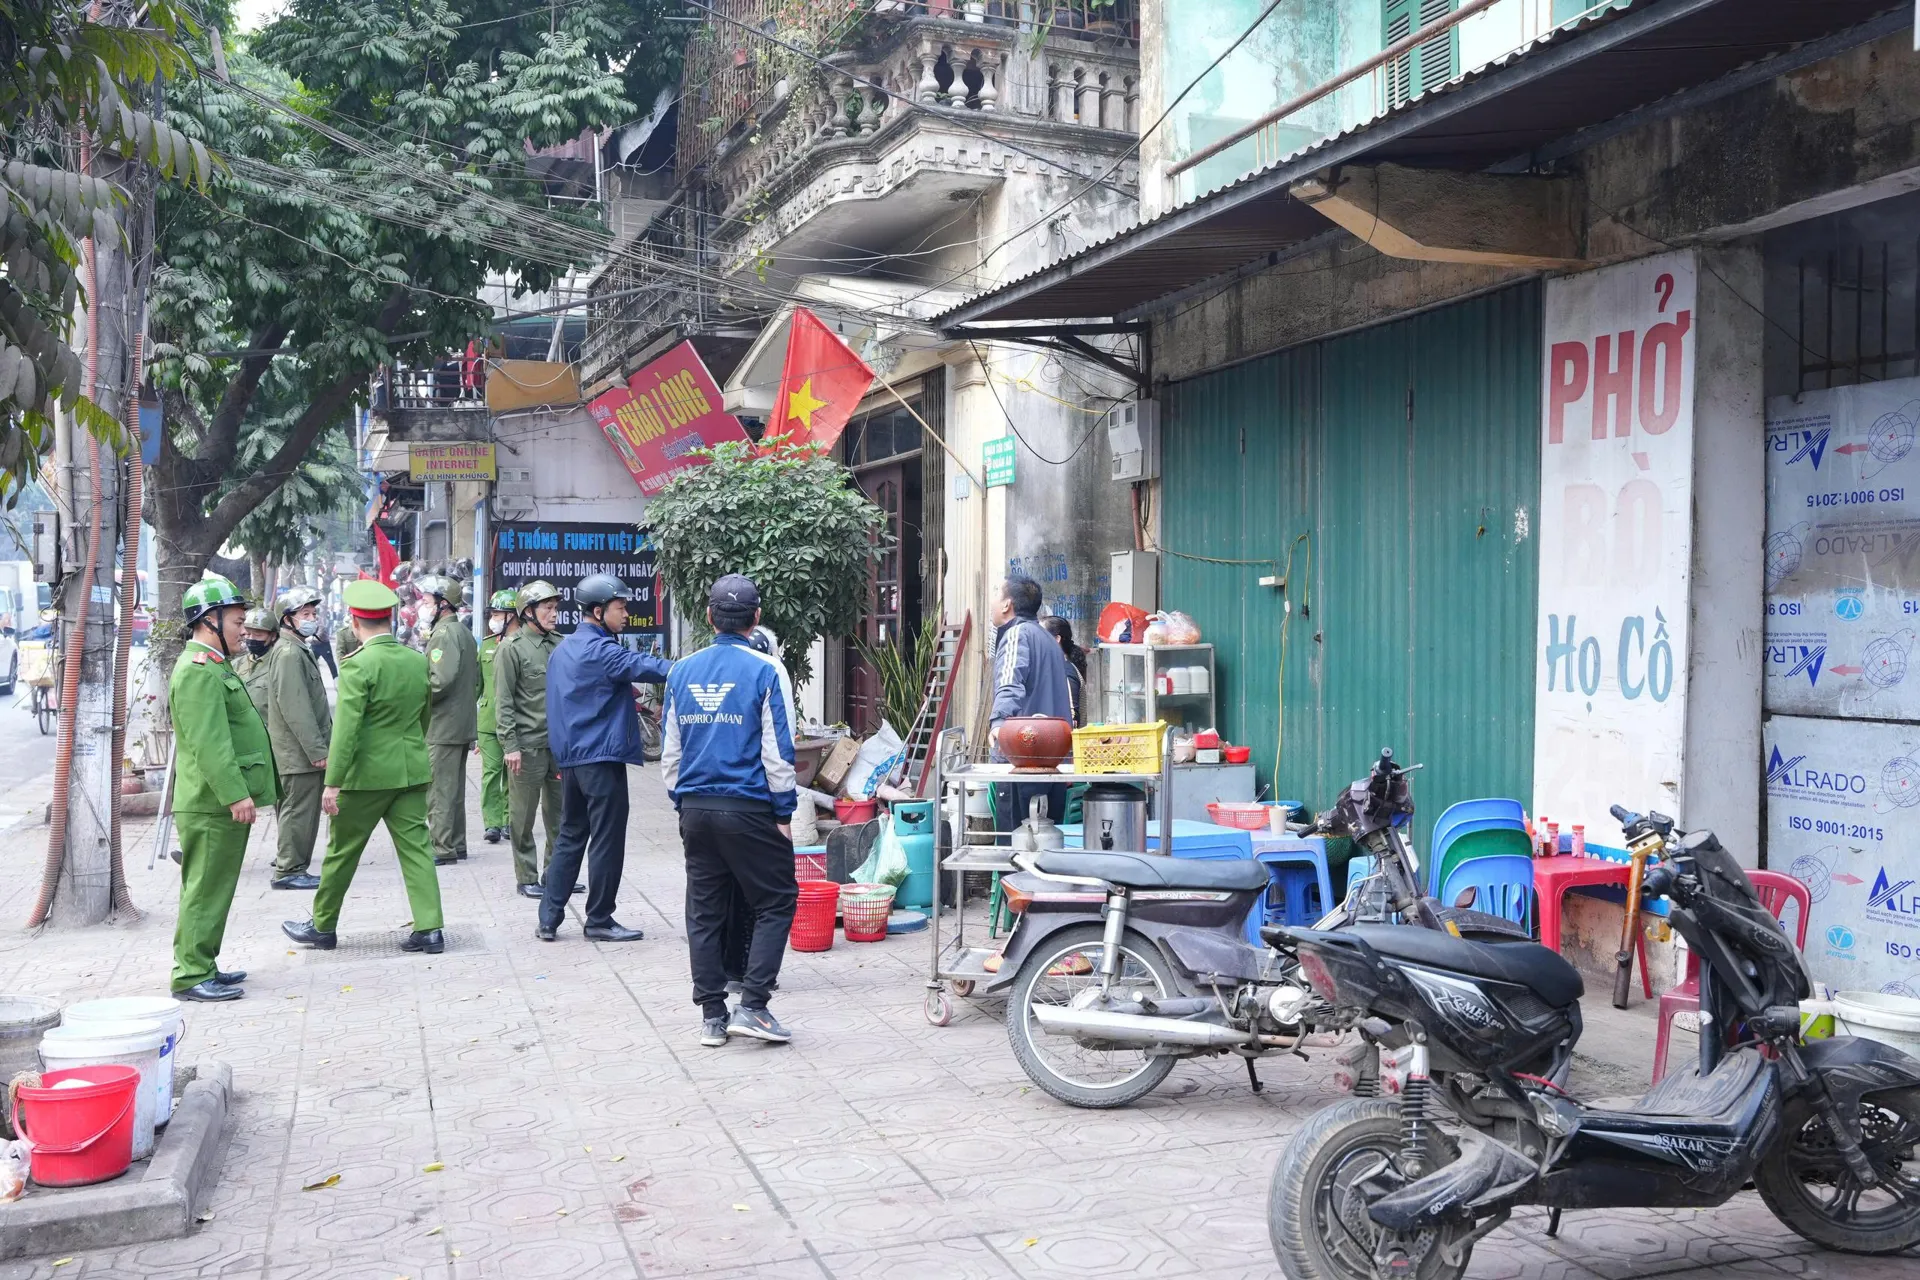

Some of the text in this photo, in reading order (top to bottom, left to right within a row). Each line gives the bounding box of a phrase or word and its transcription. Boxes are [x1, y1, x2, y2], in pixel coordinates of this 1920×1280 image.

[1549, 273, 1690, 444] PHỞ
[616, 390, 666, 446] CHÁO
[651, 368, 712, 429] LÒNG
[415, 446, 489, 457] GAME ONLINE
[426, 459, 479, 470] INTERNET
[1807, 488, 1904, 507] ISO 9001:2015
[499, 528, 515, 553] HỆ
[517, 526, 559, 551] THỐNG
[564, 532, 605, 551] FUNFIT
[607, 531, 633, 554] VIỆT
[1815, 529, 1920, 576] ALRADO
[502, 556, 652, 578] CHUYỂN ĐỔI VÓC DÁNG SAU 21 NGÀY
[637, 586, 649, 601] CƠ
[1779, 603, 1801, 616] ISO
[648, 616, 654, 626] 2
[679, 713, 713, 725] EMPORIO
[1766, 743, 1866, 794] ALRADO
[1789, 815, 1884, 842] ISO 9001:2015
[1160, 891, 1192, 900] HONDA
[1886, 941, 1911, 958] ISO
[1436, 986, 1493, 1023] X-MEN
[1654, 1134, 1704, 1152] OSAKAR
